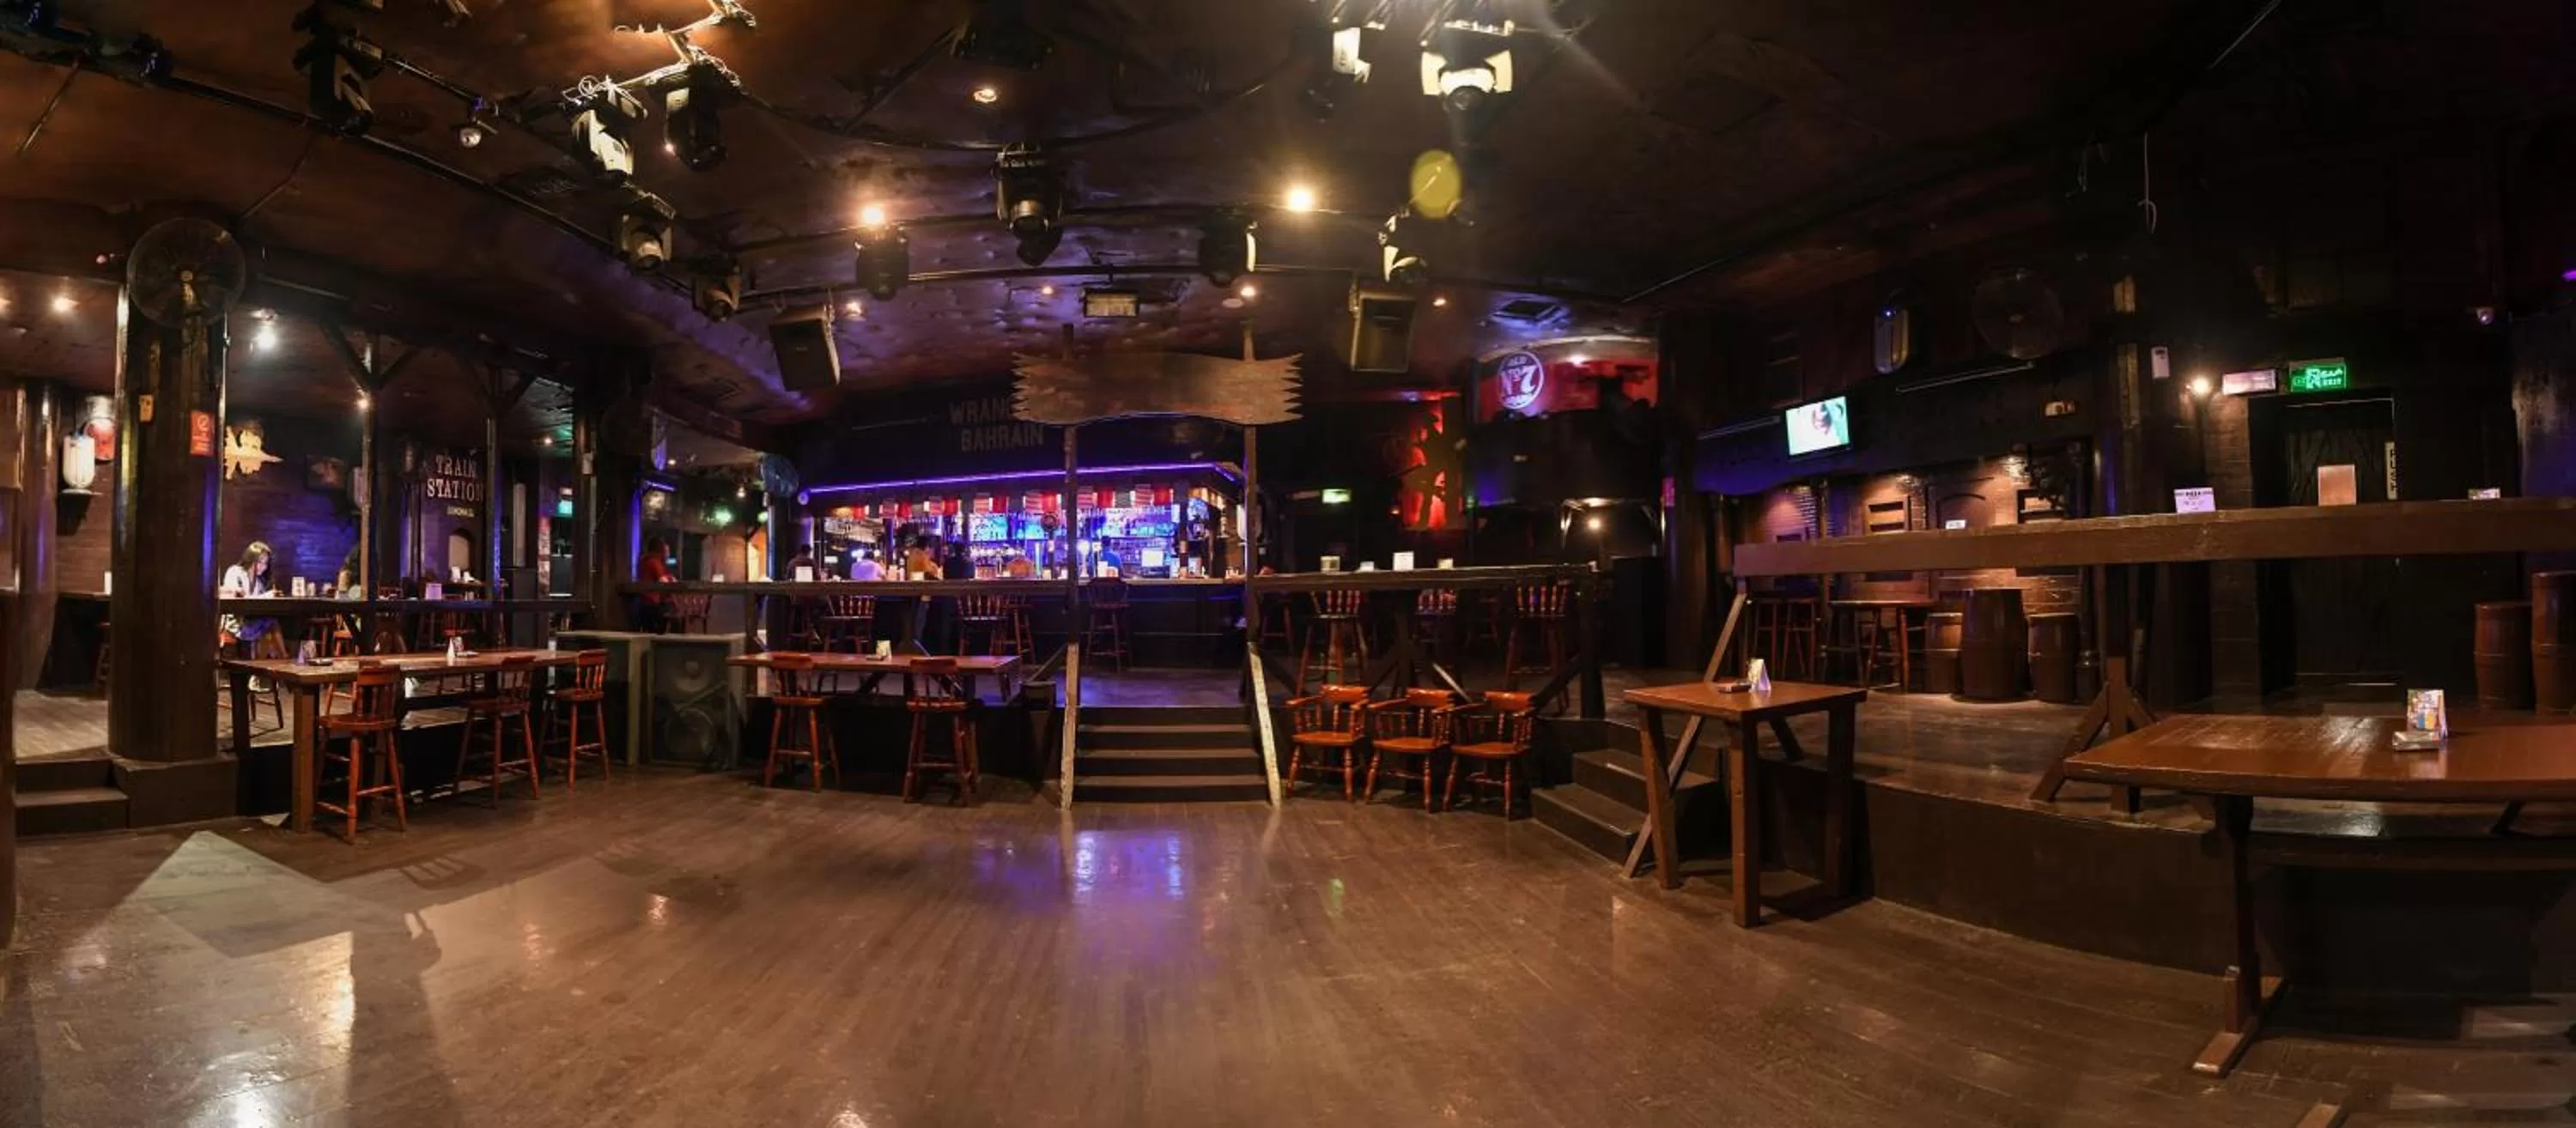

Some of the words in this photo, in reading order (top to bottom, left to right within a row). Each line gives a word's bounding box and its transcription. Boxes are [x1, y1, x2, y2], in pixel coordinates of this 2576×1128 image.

[961, 422, 1045, 452] BAHRAIN
[435, 454, 477, 478] TRAIN
[427, 478, 484, 502] STATION
